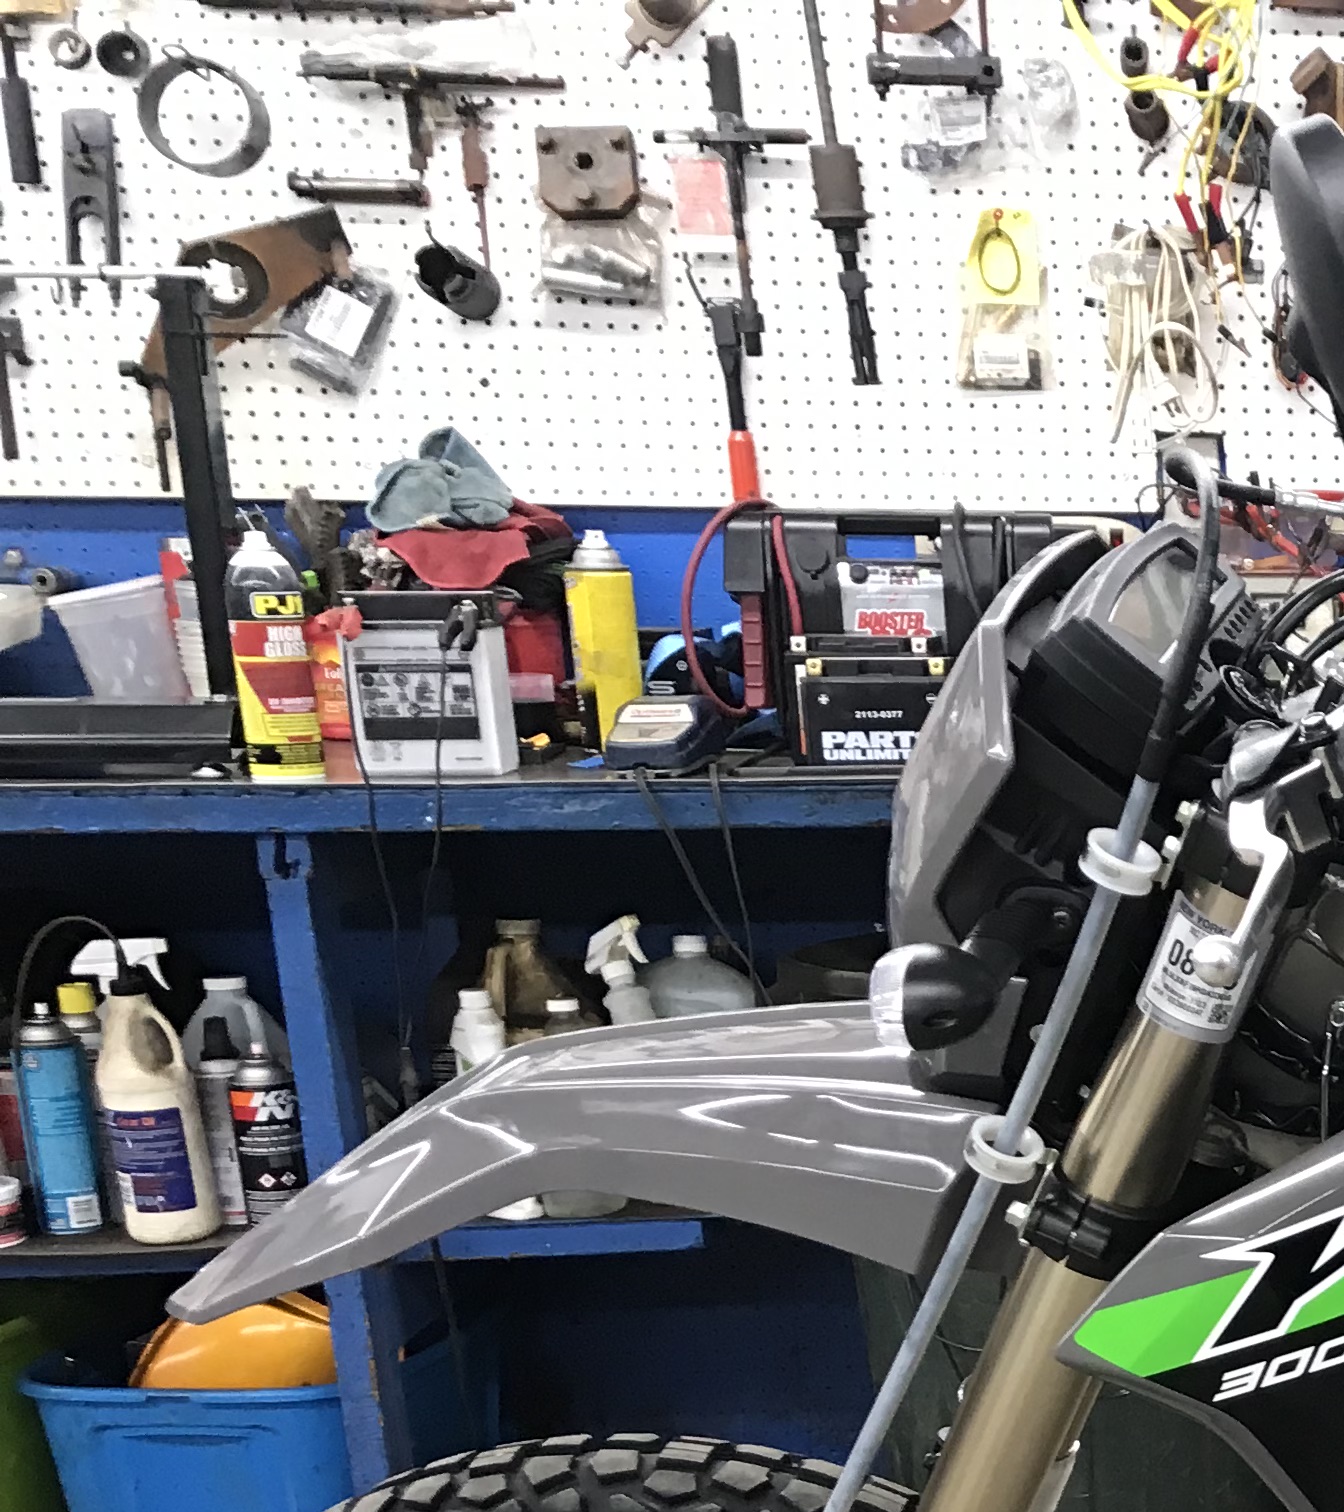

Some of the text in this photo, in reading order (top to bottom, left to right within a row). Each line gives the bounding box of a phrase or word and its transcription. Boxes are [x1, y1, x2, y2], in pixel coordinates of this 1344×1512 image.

[857, 610, 925, 630] BOOSTER
[265, 625, 304, 642] HIGH
[264, 640, 307, 658] GLOSS
[823, 747, 911, 761] UNLIMIT
